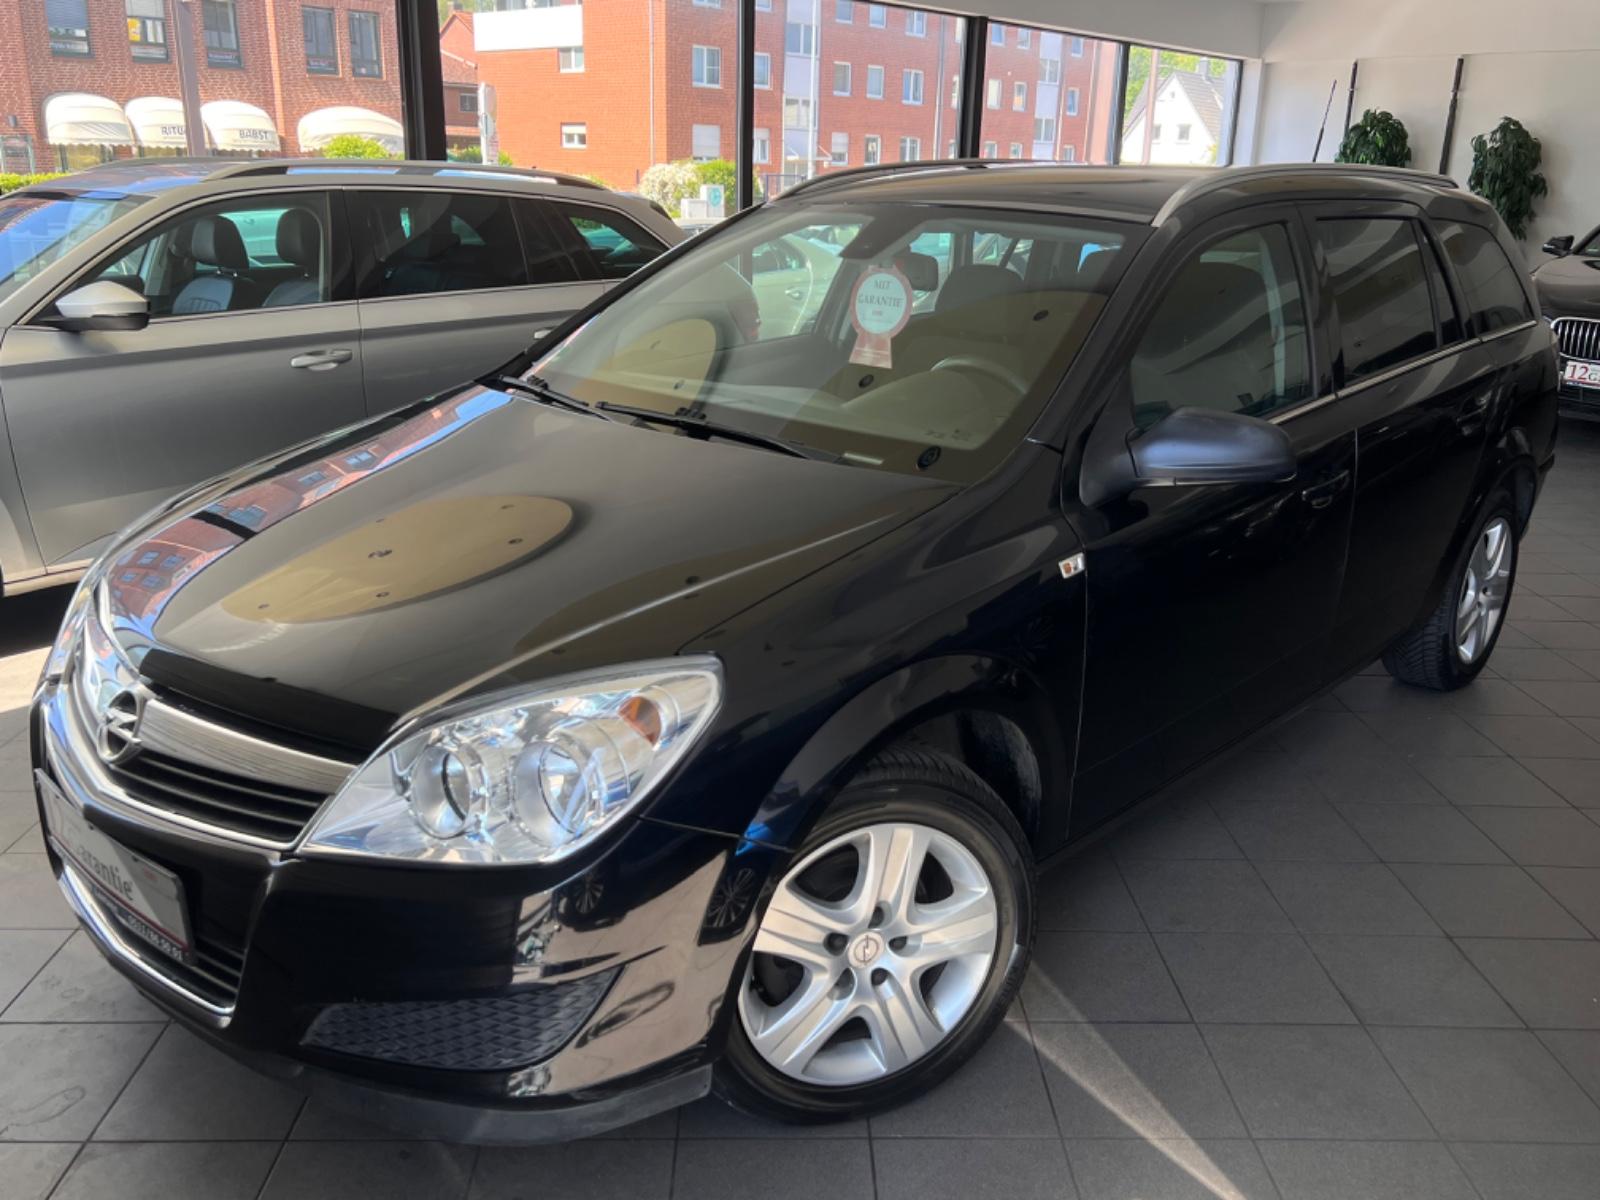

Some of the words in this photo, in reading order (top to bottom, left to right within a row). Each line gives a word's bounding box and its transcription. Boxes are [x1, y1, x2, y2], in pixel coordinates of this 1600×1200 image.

[873, 280, 891, 290] MIT
[857, 295, 904, 308] GARANTIE
[1568, 364, 1589, 380] 12
